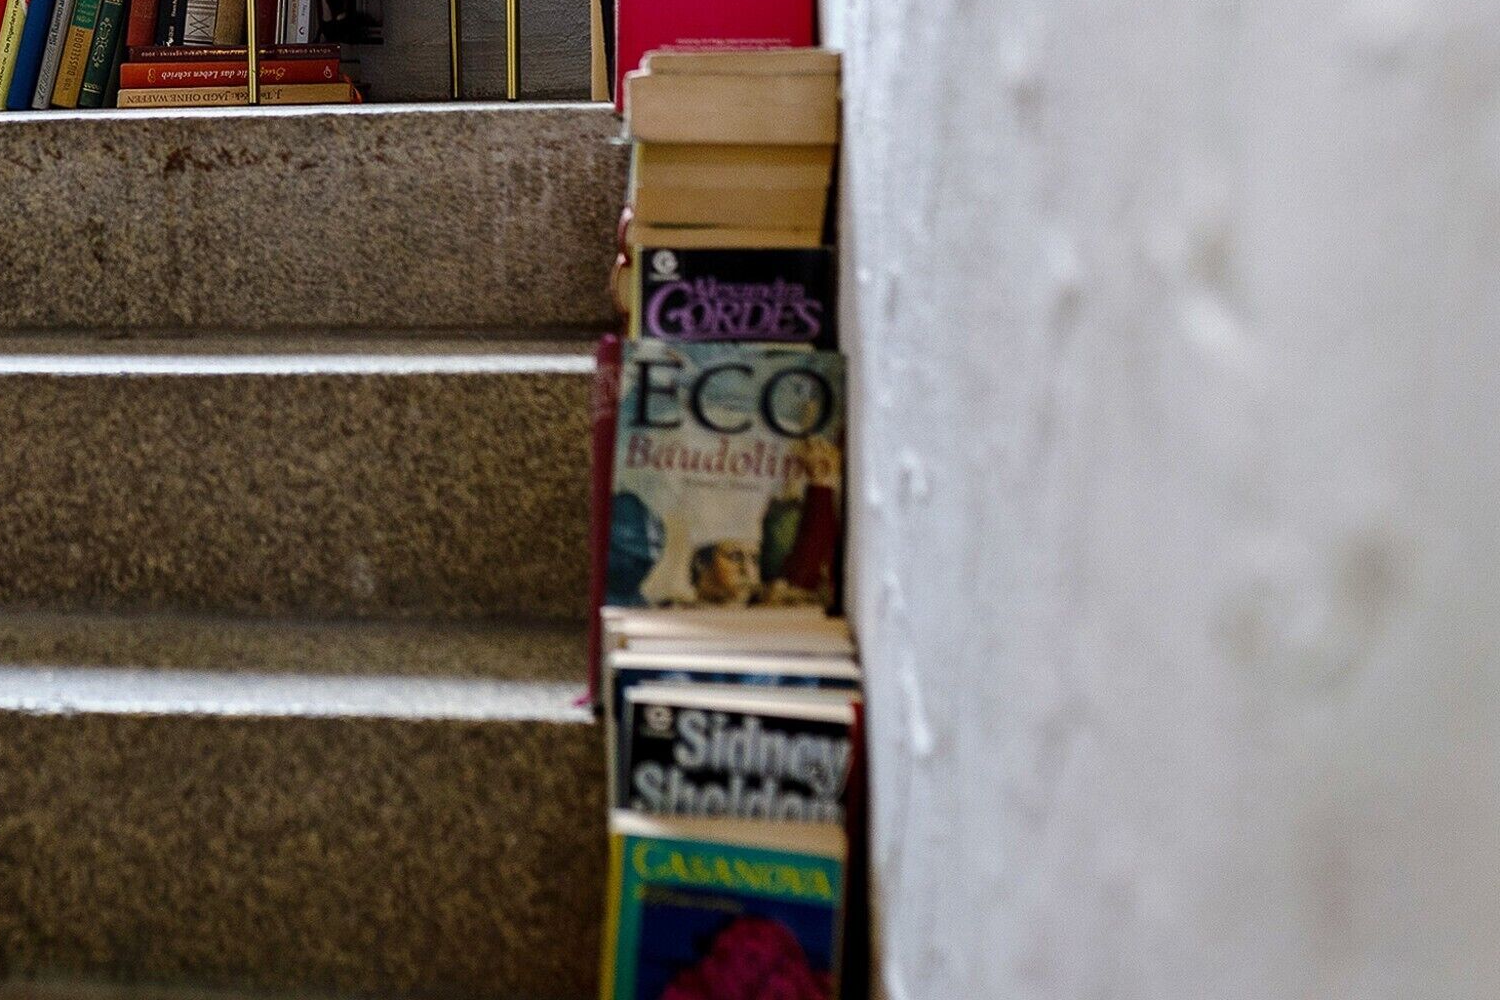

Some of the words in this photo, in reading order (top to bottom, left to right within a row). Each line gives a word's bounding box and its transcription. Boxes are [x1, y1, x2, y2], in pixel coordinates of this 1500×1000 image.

[161, 71, 192, 80] schrieb
[193, 70, 218, 79] Leben
[220, 70, 235, 78] das
[126, 94, 167, 103] WAFFEN
[169, 93, 201, 101] OHNE
[203, 91, 230, 100] JAGD
[646, 281, 822, 342] GORDES
[630, 358, 834, 439] ECO
[625, 434, 834, 481] Baudolino
[673, 710, 853, 792] Sidney
[632, 760, 845, 825] Sheldon
